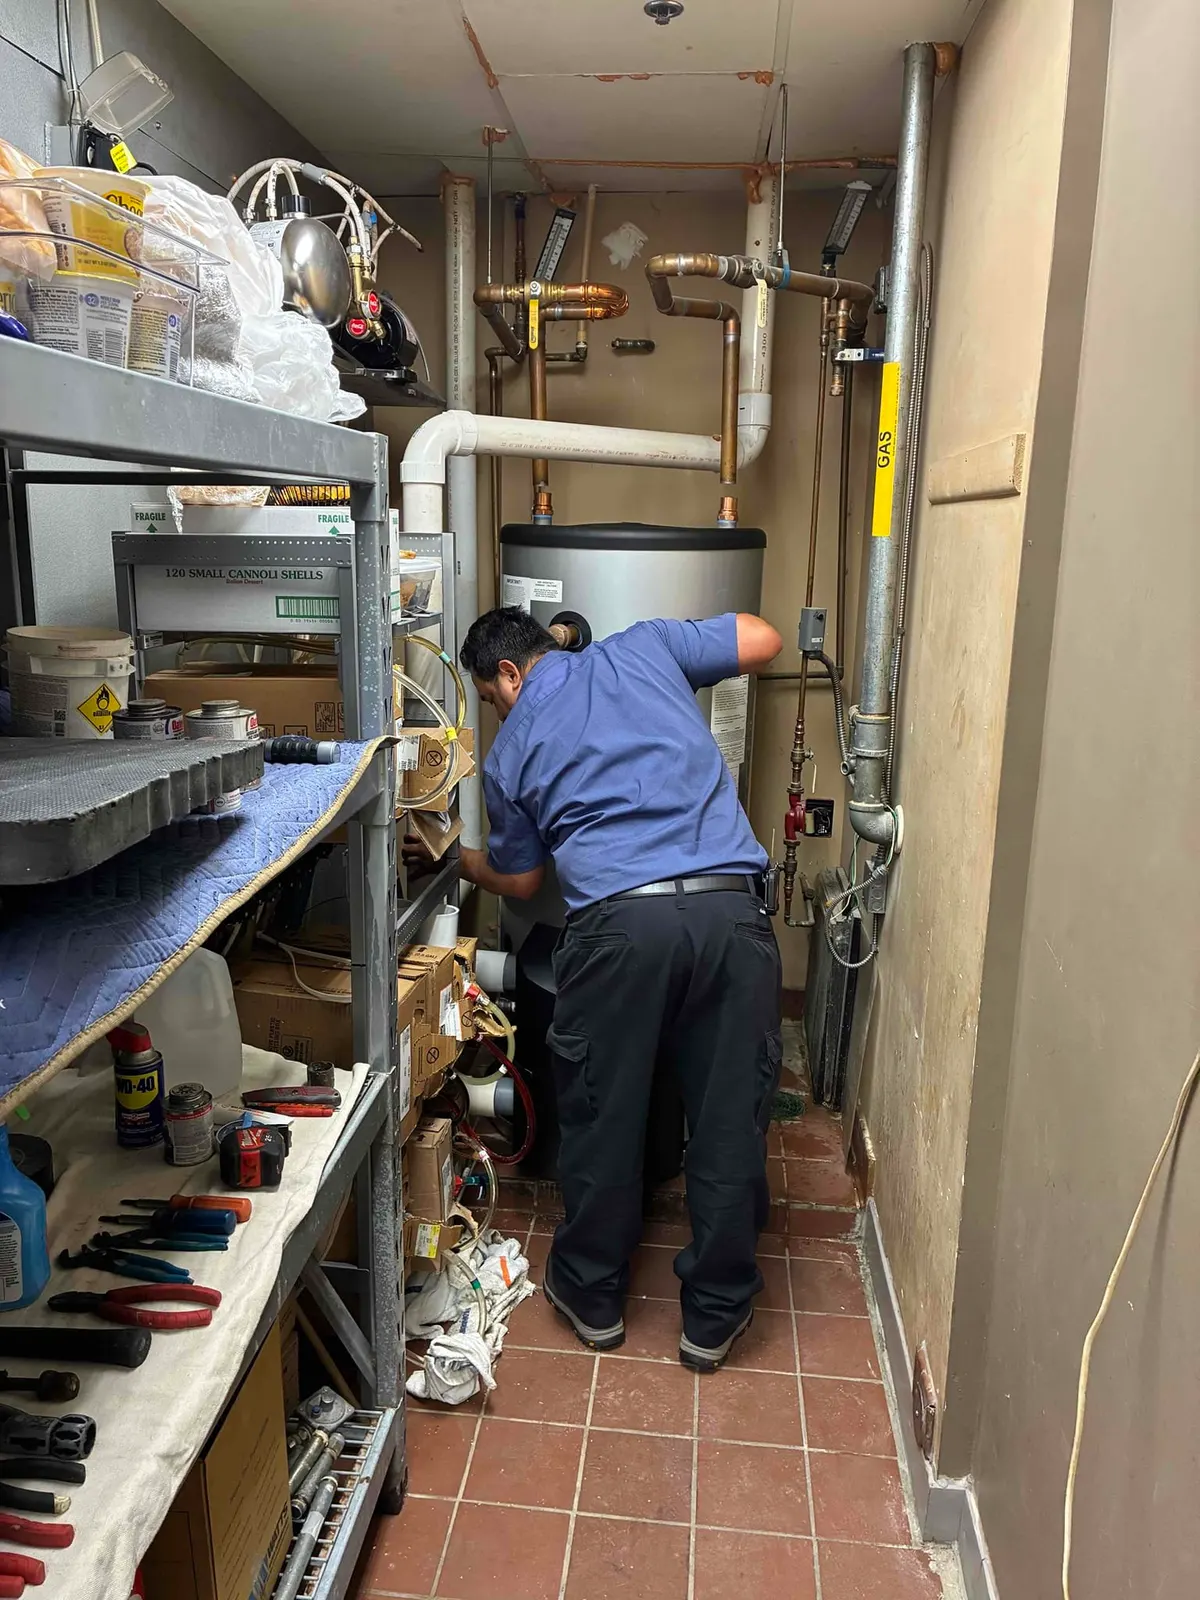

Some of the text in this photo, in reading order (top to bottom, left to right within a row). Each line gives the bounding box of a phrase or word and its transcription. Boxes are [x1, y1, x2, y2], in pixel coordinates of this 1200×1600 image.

[877, 431, 892, 468] GAS
[135, 512, 166, 521] FRAGILE
[317, 514, 350, 524] FRAGILE
[165, 568, 324, 580] 120 SMALL CANNOLI SHELLS
